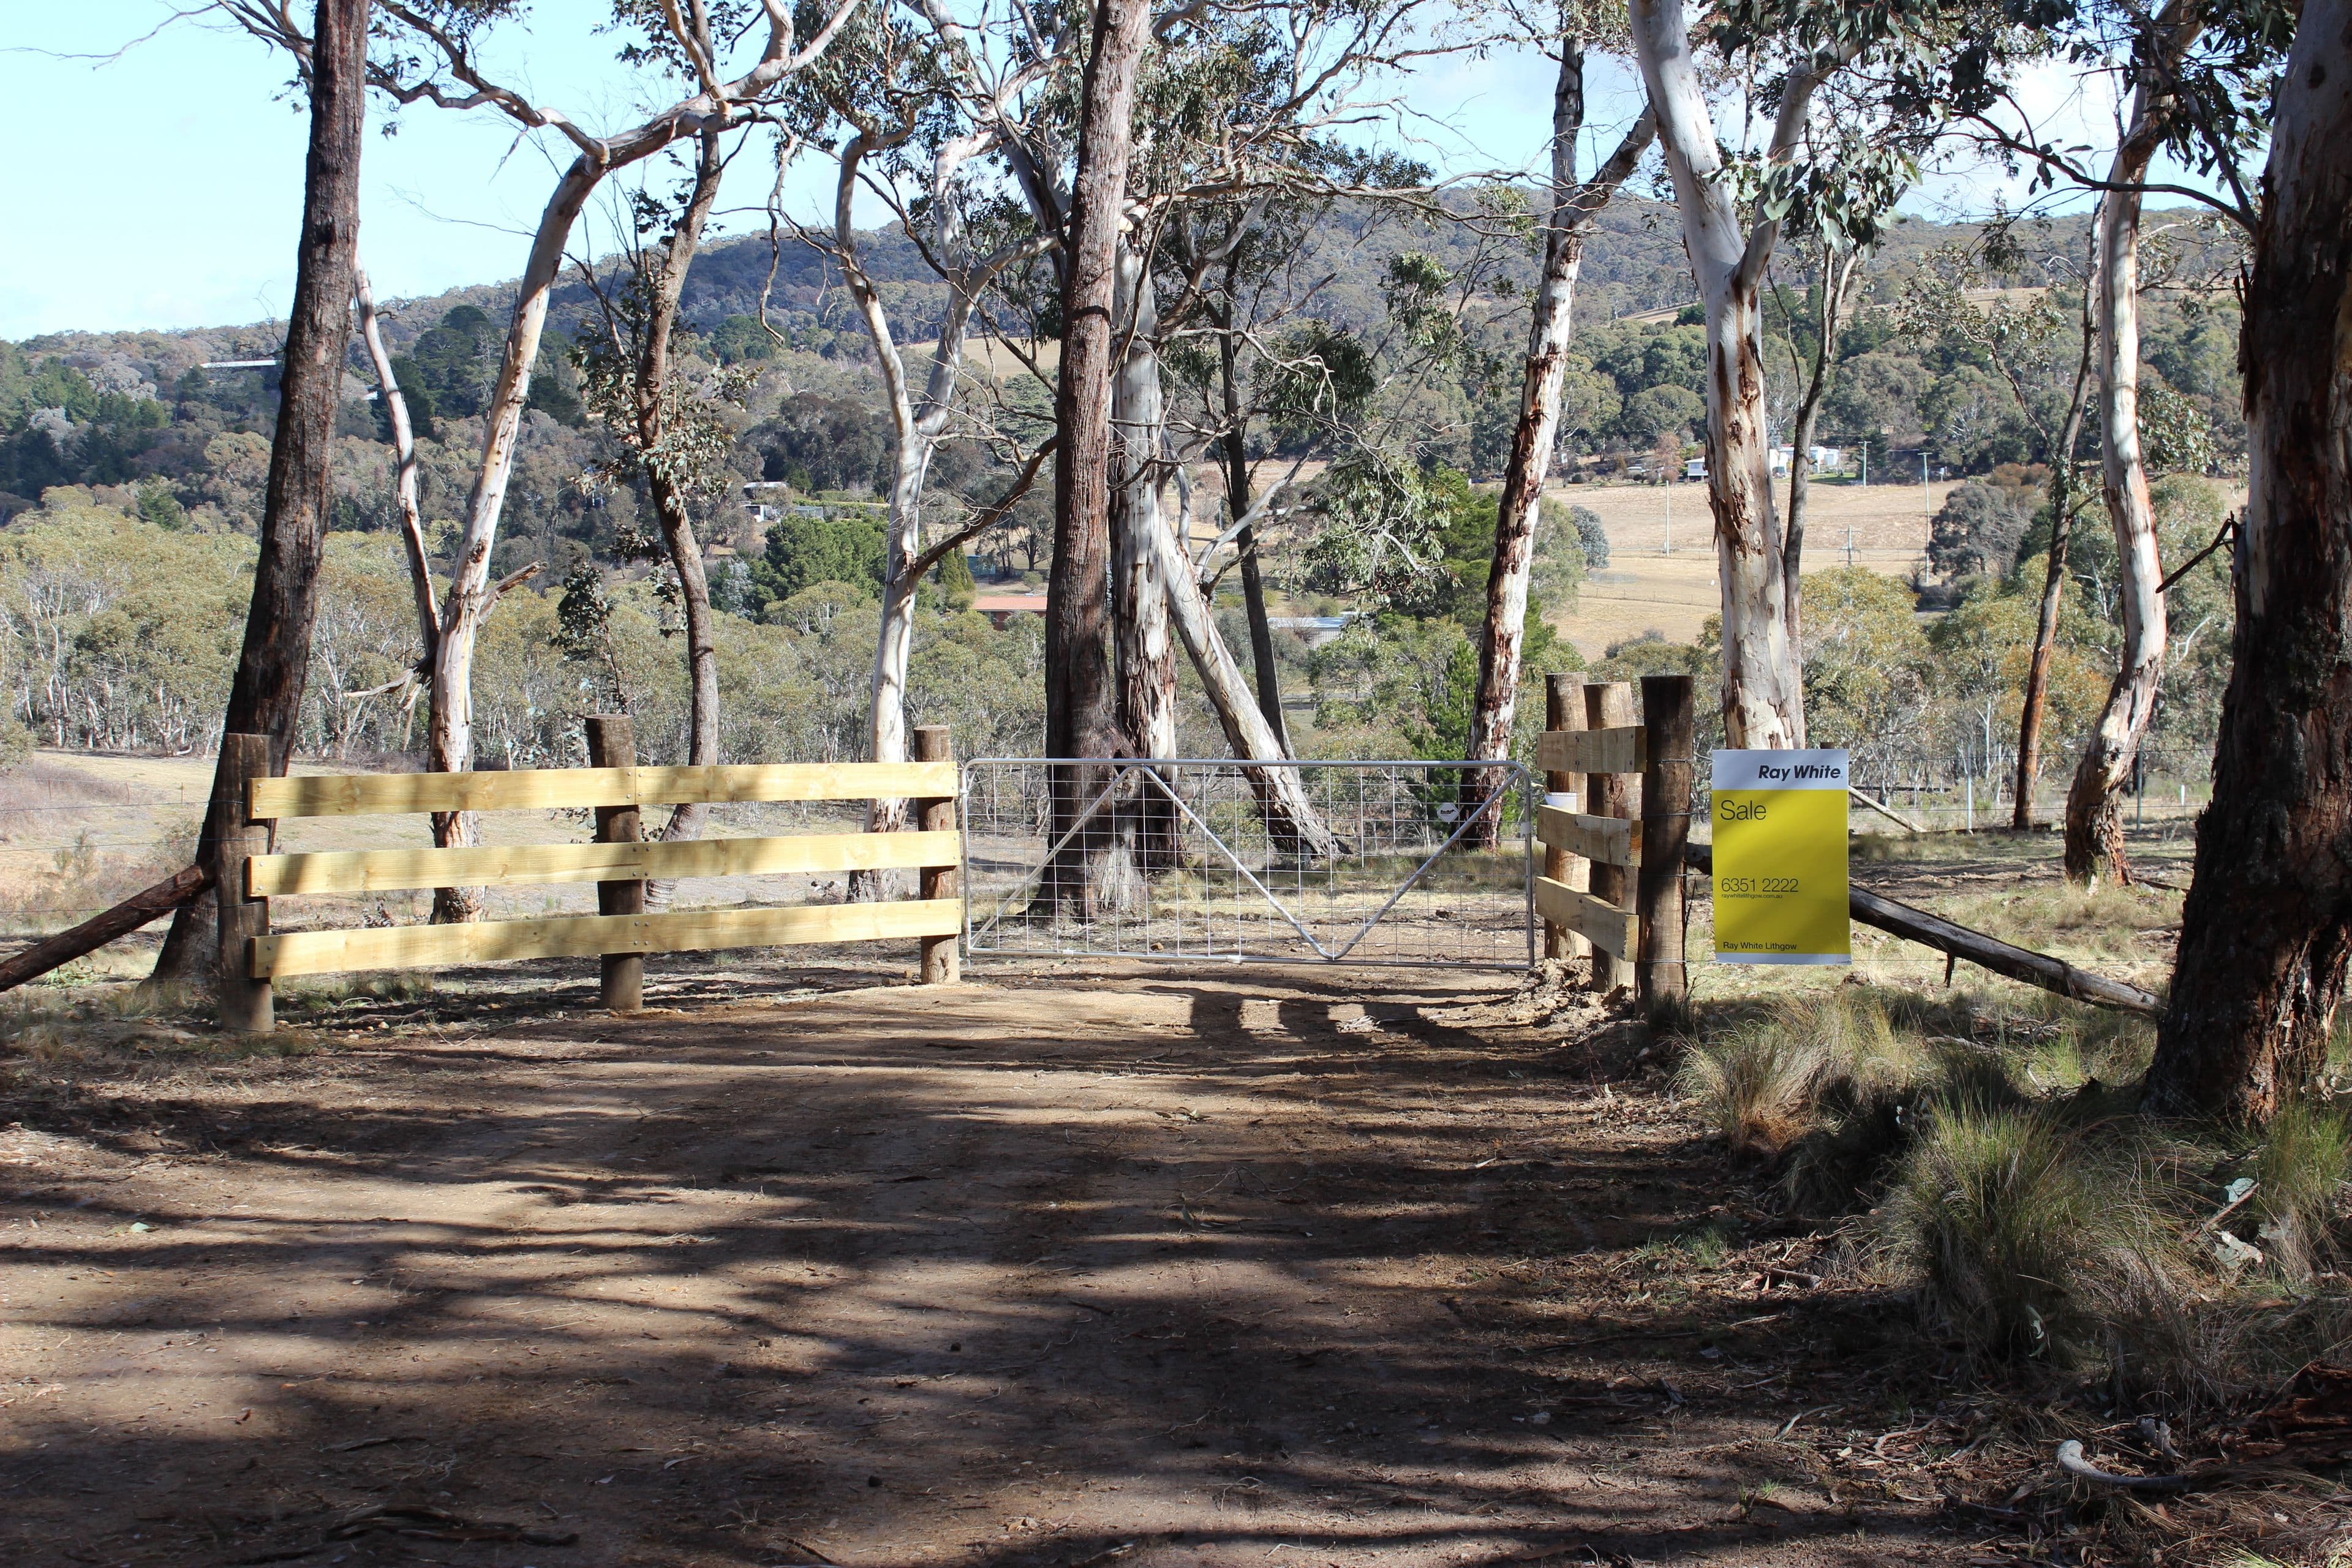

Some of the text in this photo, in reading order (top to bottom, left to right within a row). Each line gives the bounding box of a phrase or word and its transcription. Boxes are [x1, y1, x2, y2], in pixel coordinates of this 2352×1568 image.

[1758, 764, 1841, 782] Ray White
[1721, 799, 1766, 821] Sale
[1721, 878, 1799, 892] 6351 2222
[1723, 941, 1738, 950] Ray
[1765, 942, 1797, 951] Lithgow
